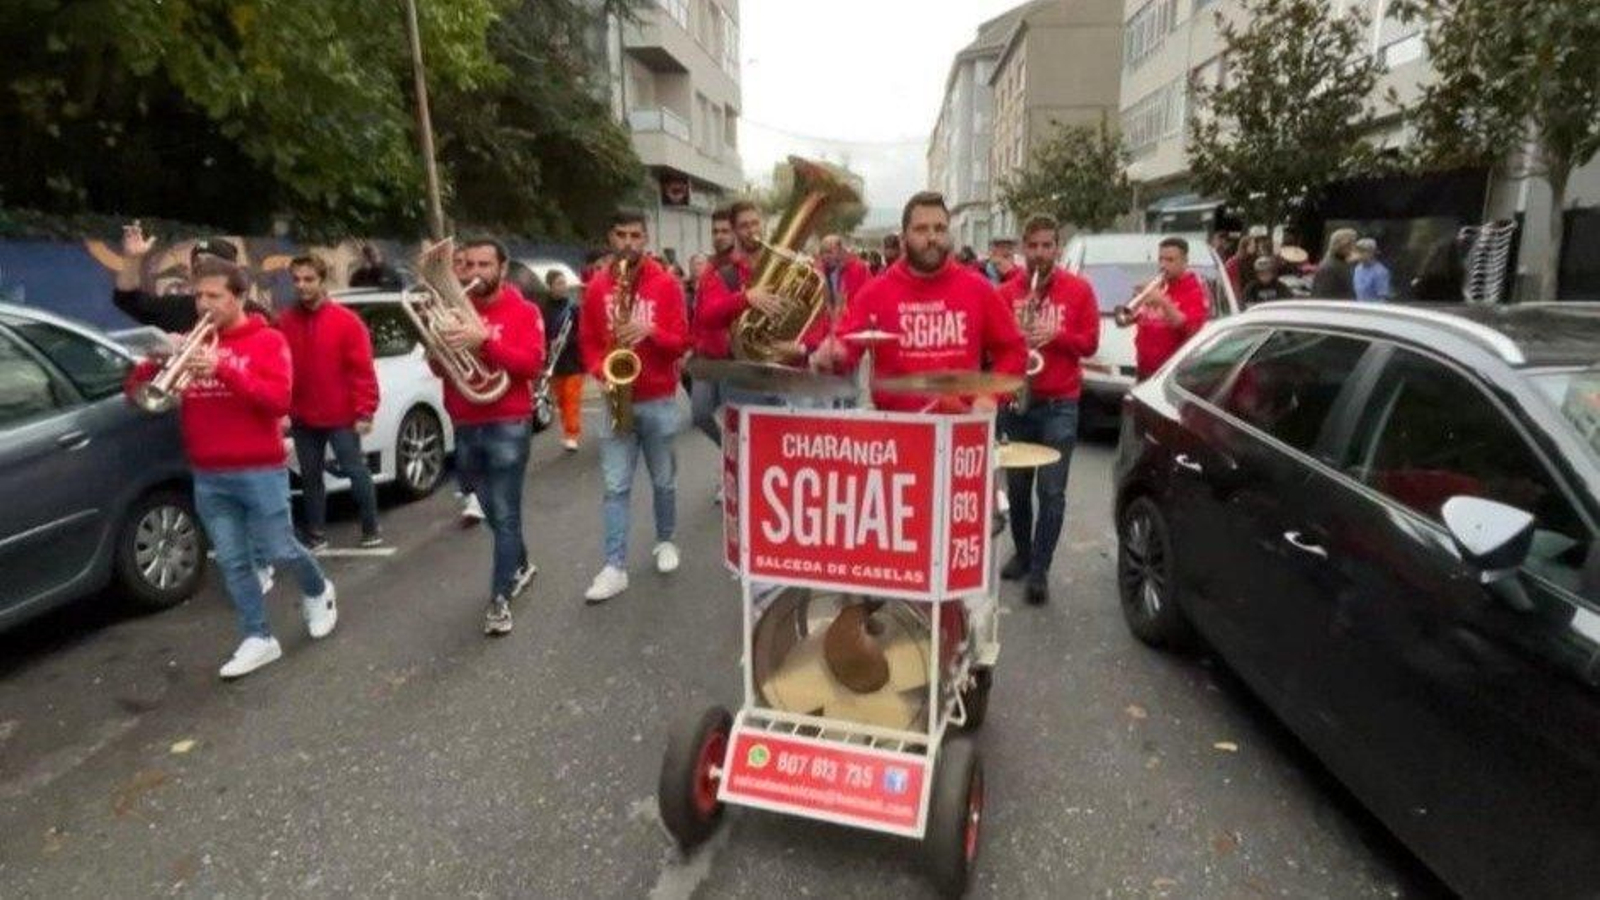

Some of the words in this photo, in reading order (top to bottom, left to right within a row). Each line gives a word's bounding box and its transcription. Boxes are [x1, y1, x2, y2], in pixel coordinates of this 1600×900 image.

[899, 310, 968, 348] SGHAE
[782, 433, 898, 466] CHARANGA
[954, 445, 985, 479] 607
[761, 465, 918, 553] SGHAE
[755, 555, 823, 574] SALCEDA
[827, 563, 847, 576] DE
[852, 565, 925, 583] CASELAS
[951, 535, 980, 570] 735
